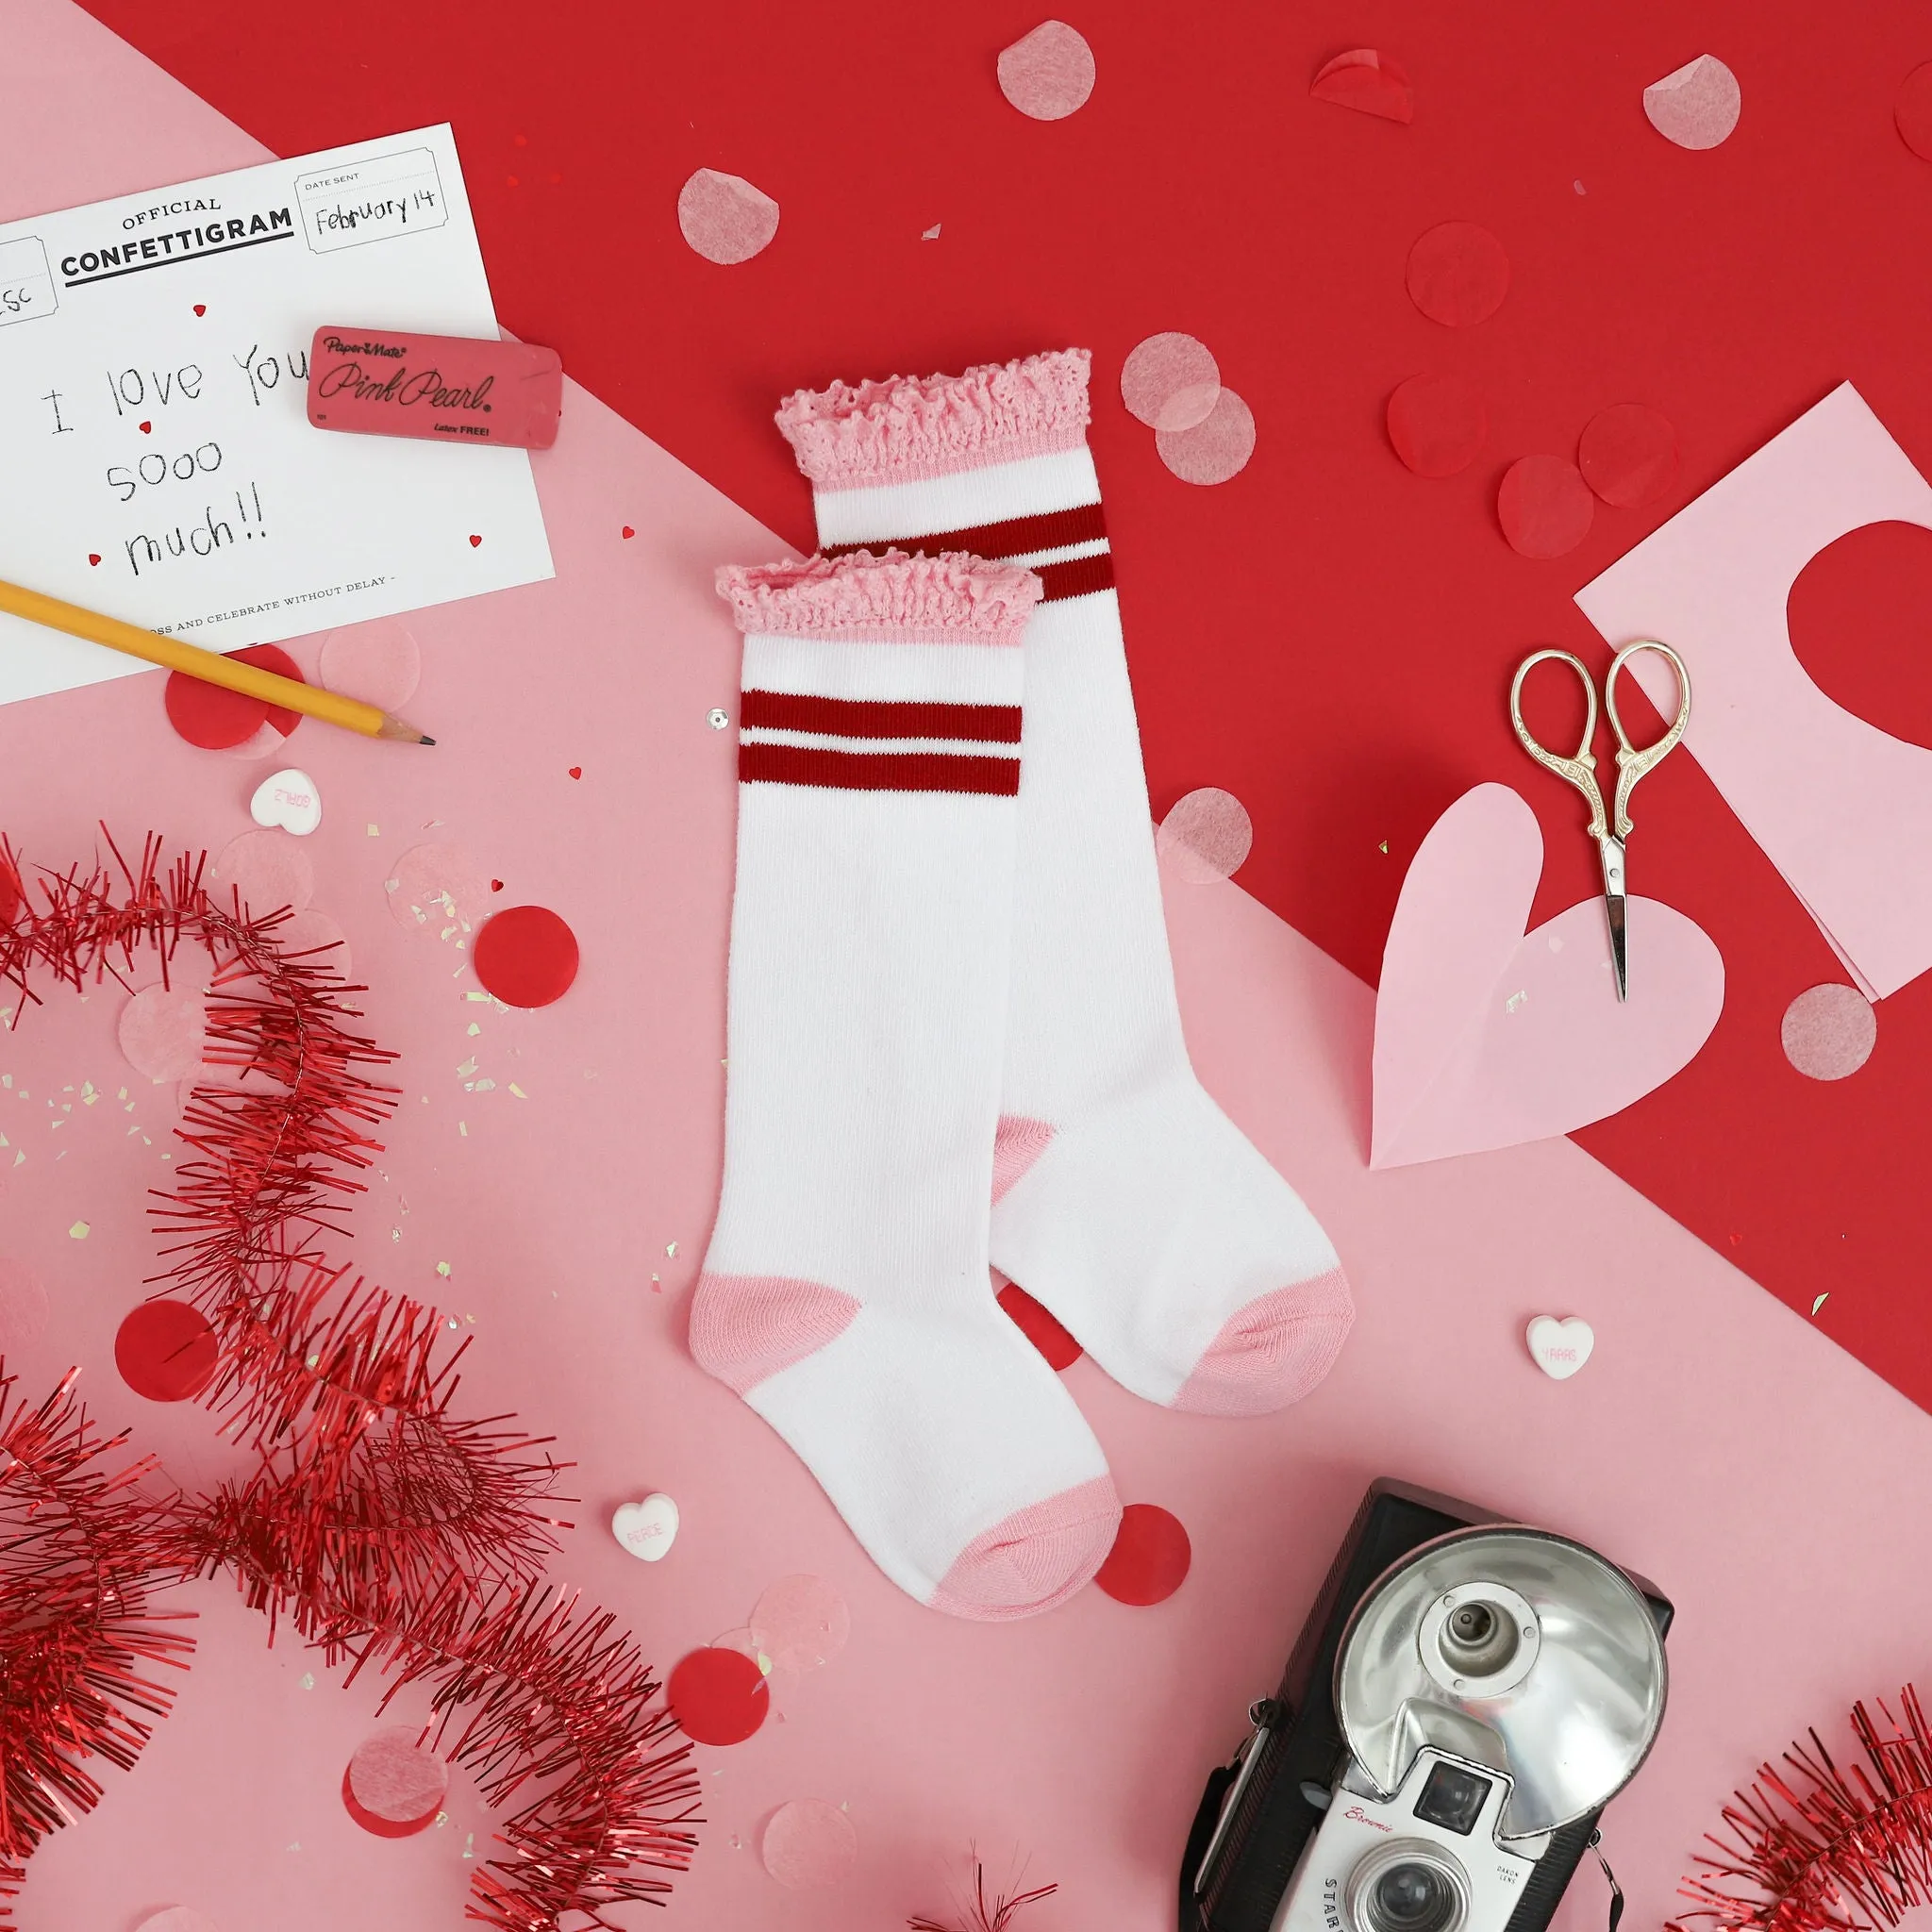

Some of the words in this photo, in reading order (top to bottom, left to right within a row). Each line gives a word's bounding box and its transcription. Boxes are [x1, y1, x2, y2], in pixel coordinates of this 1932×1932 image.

[305, 179, 331, 191] DATE
[333, 173, 359, 185] SENT
[122, 198, 222, 230] OFFICIAL
[316, 197, 407, 235] February
[413, 189, 435, 209] 14
[60, 207, 293, 276] CONFETTIGRAM
[323, 336, 364, 356] Paper
[42, 389, 74, 434] I
[107, 363, 203, 416] love
[318, 361, 407, 403] Pink
[433, 423, 458, 434] Latex
[459, 425, 490, 437] FREE!
[125, 481, 267, 576] much!!
[177, 618, 204, 631] AND
[207, 601, 281, 625] CELEBRATE
[283, 586, 342, 607] WITHOUT
[345, 576, 387, 593] DELAY
[1343, 1807, 1393, 1833] Brownie
[1324, 1877, 1344, 1932] STAR
